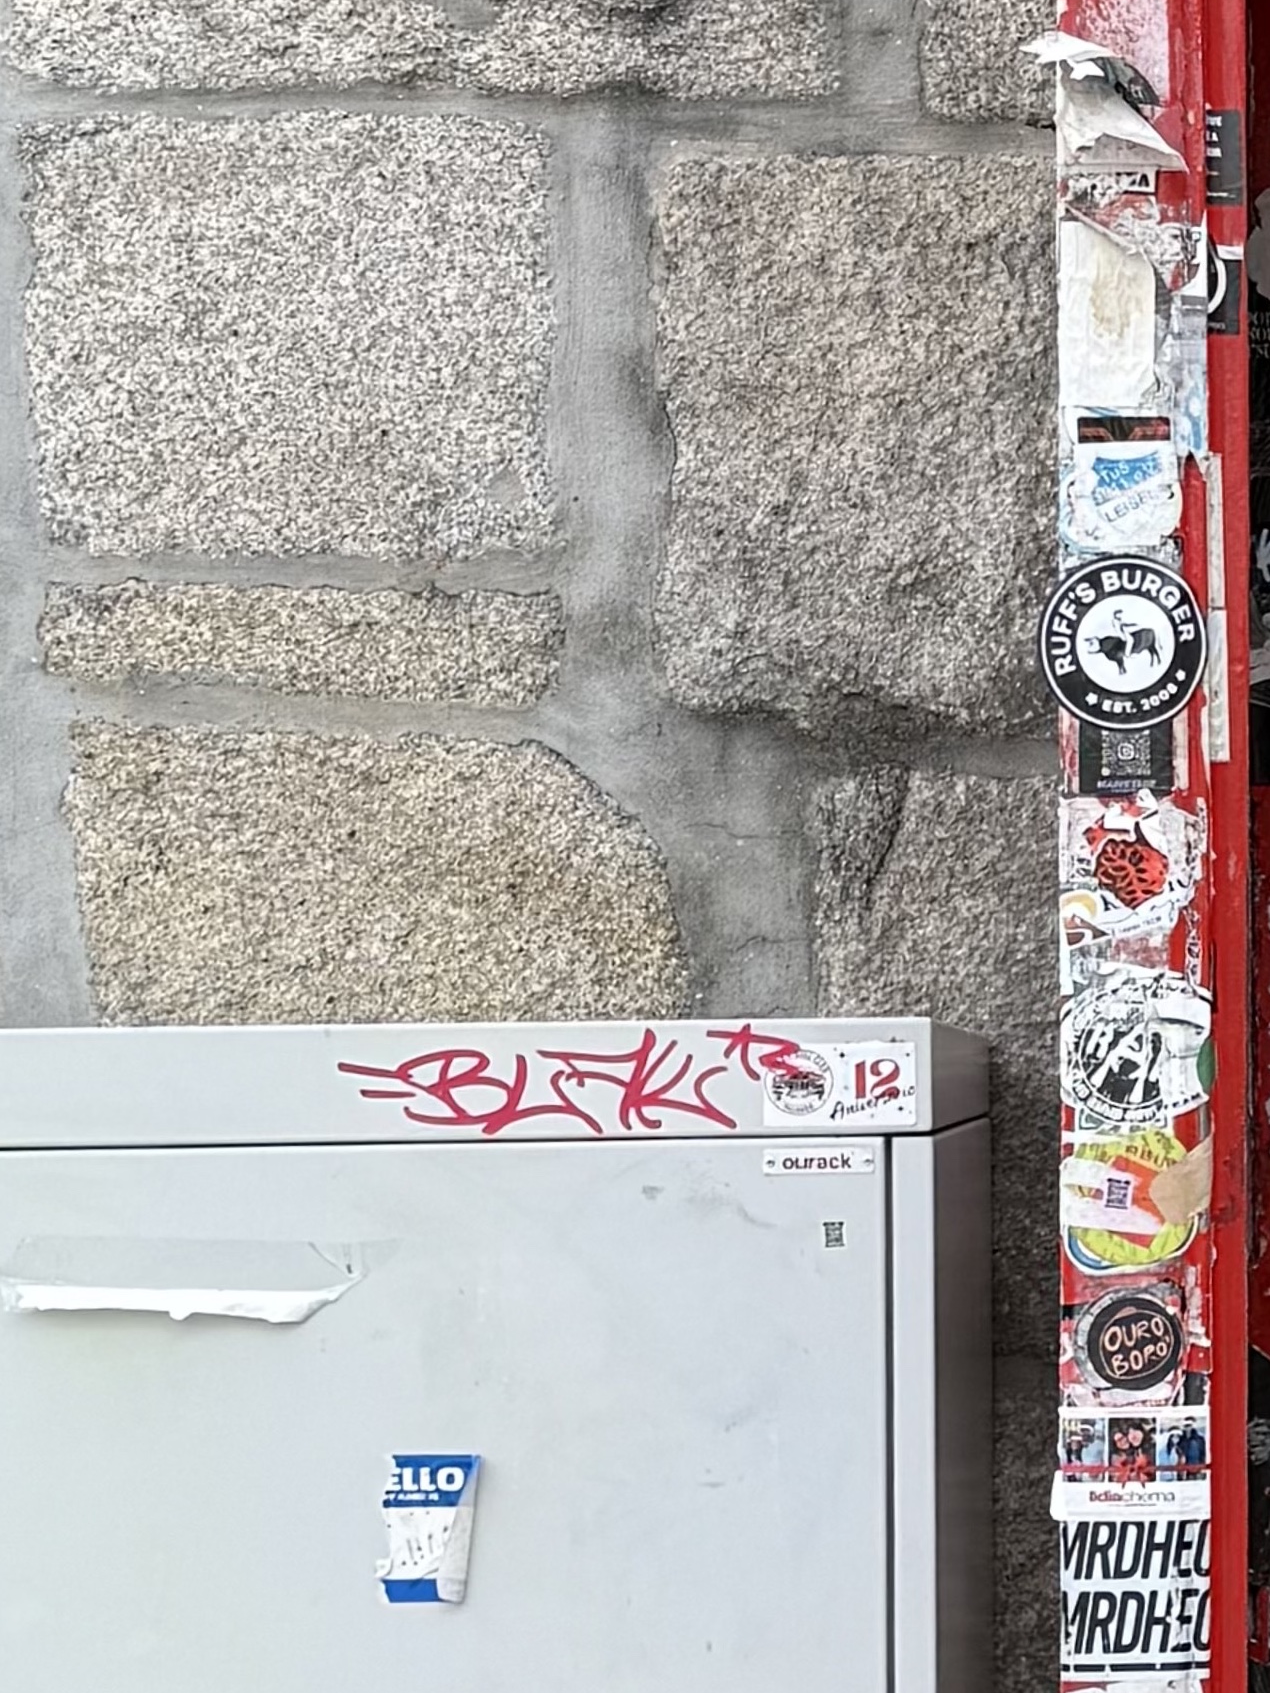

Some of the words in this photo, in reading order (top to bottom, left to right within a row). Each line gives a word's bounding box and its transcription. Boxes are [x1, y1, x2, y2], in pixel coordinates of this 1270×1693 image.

[1051, 580, 1098, 677] RUFF'S
[1101, 569, 1196, 644] BURGER
[1101, 694, 1139, 715] EST.
[853, 1058, 902, 1100] 12
[1103, 1313, 1167, 1352] OURO
